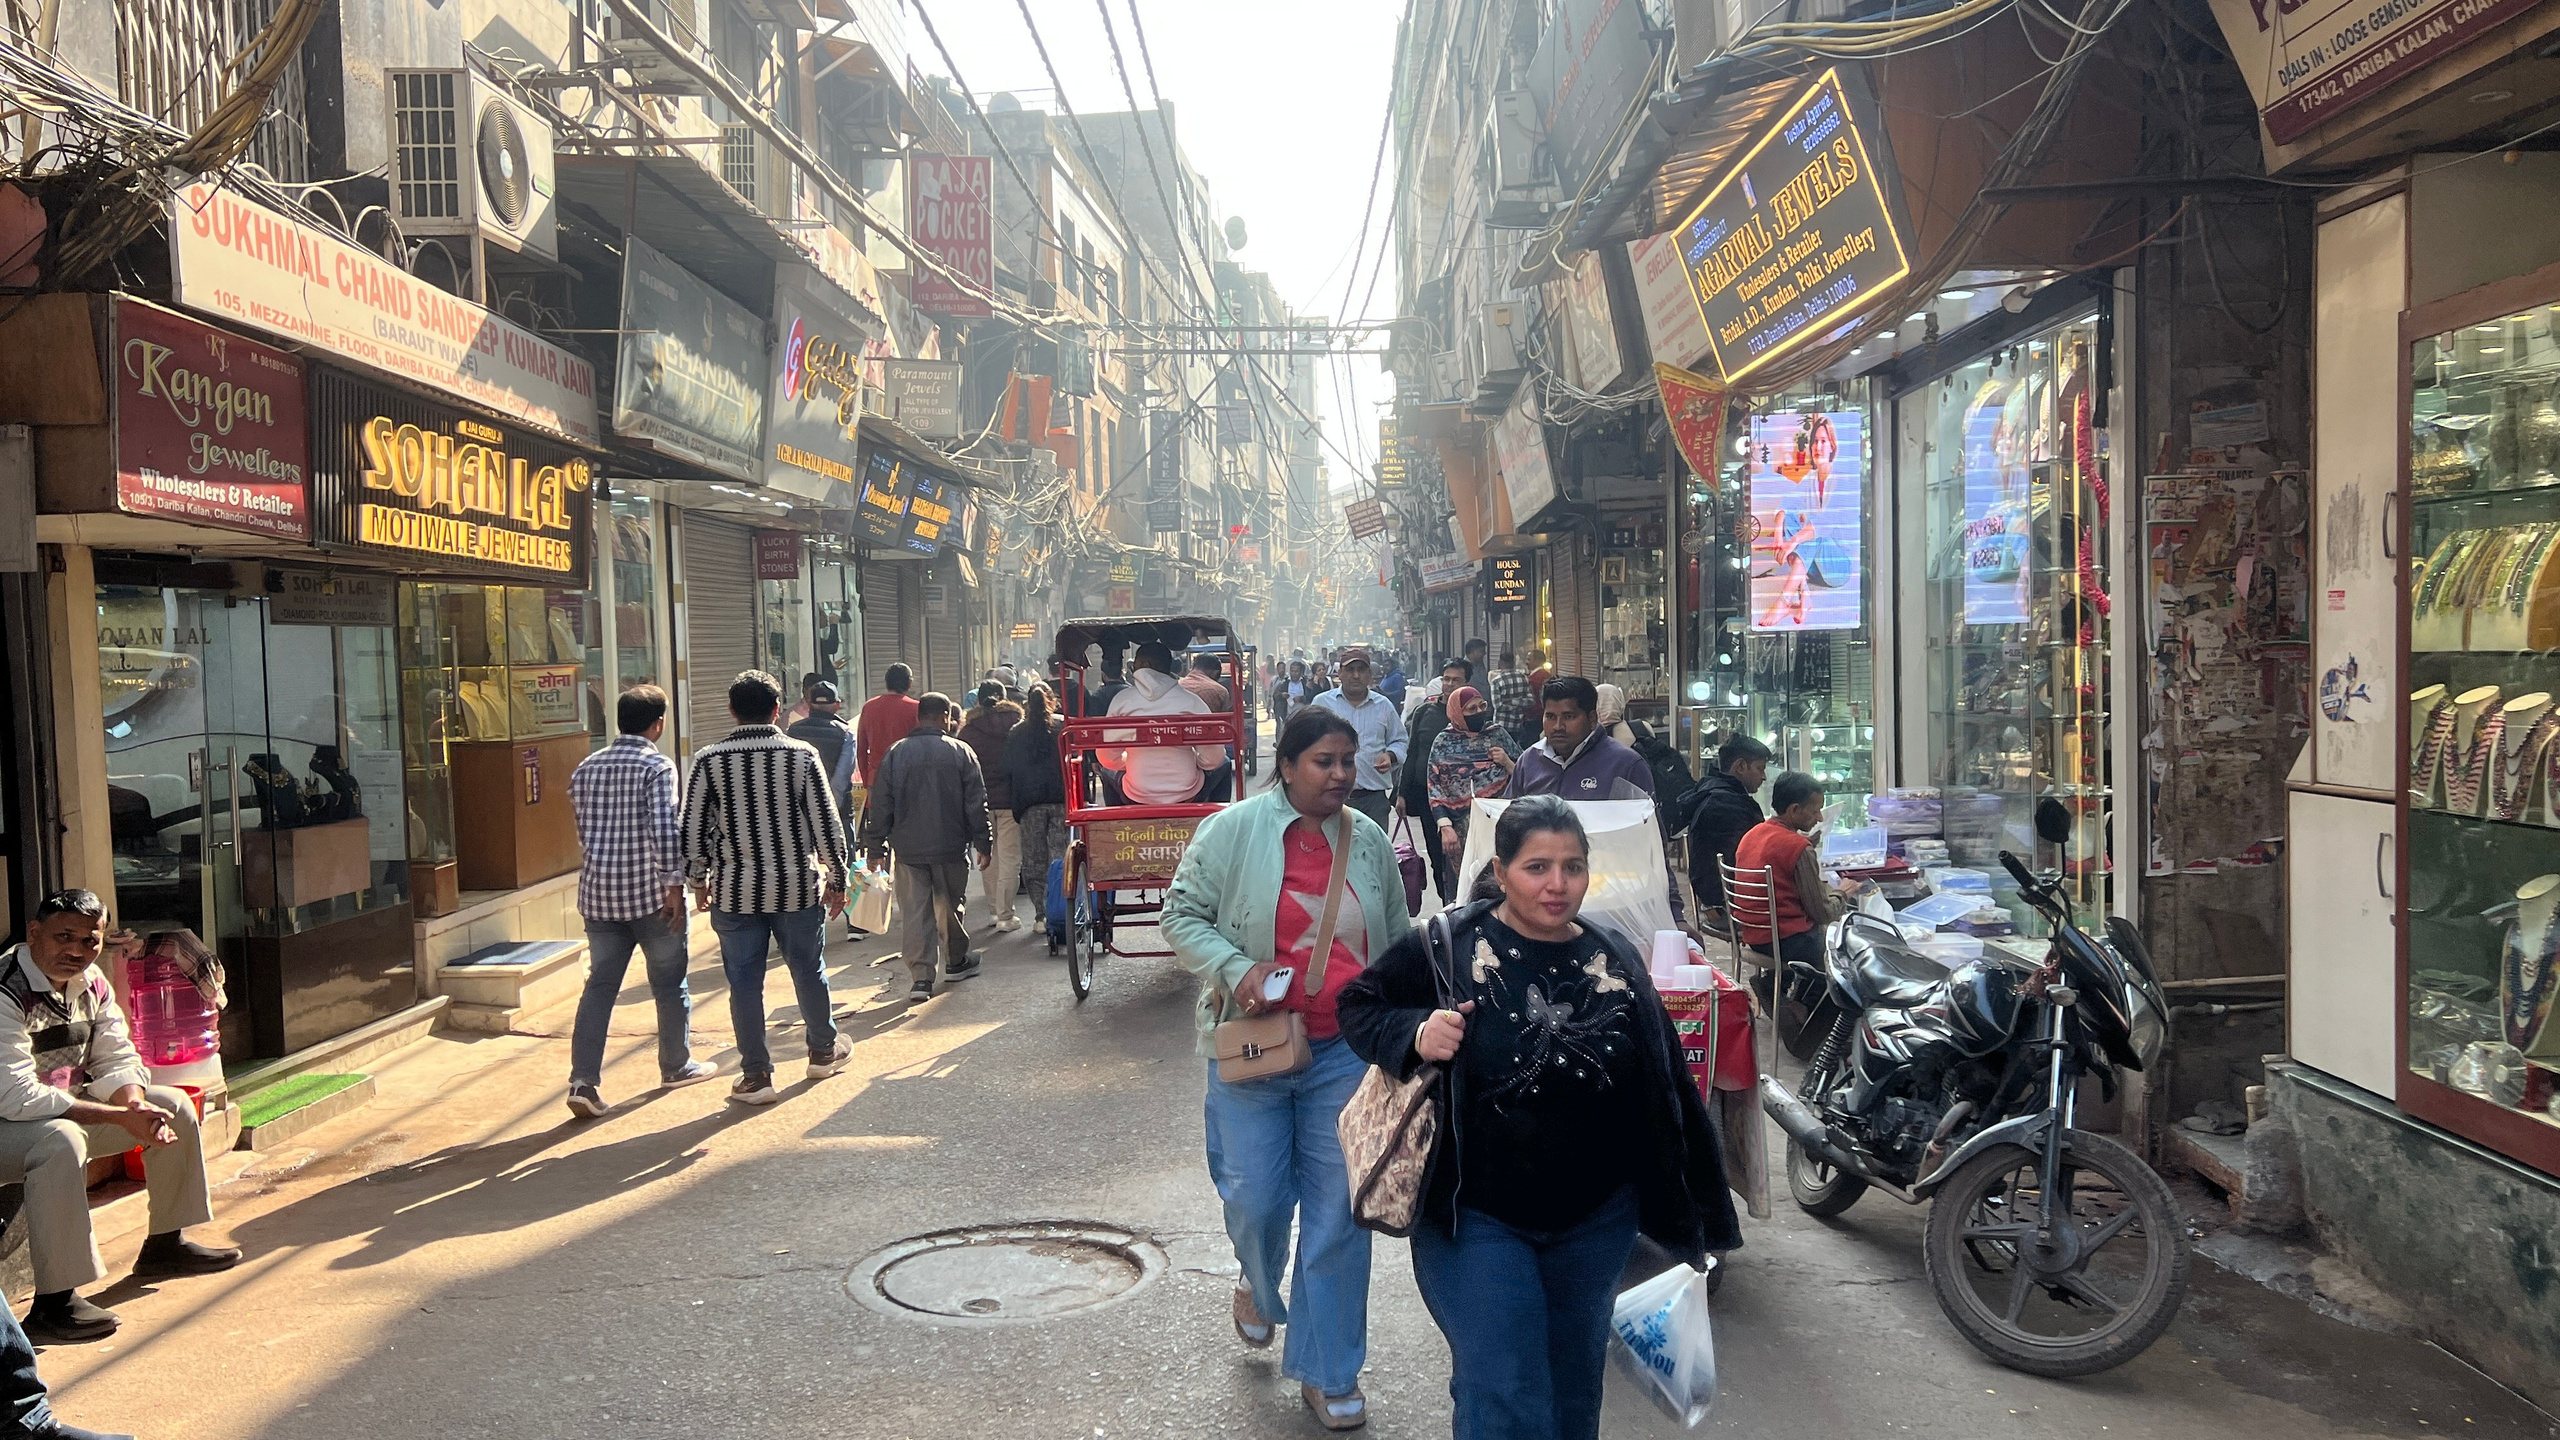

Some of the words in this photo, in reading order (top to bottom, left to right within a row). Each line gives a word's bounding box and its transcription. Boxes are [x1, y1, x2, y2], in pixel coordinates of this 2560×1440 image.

[2277, 57, 2310, 87] DEALS
[2310, 45, 2325, 70] IN
[2331, 23, 2369, 56] LOOSE
[2342, 48, 2397, 88] DARIBA
[2396, 17, 2453, 60] KALAN,
[916, 200, 988, 240] POCKET
[1695, 213, 1774, 304] AGARWAL
[1769, 136, 1858, 241] JEWELS
[1736, 265, 1781, 303] Wholesalers
[1778, 253, 1789, 273] &
[1784, 229, 1823, 268] Retailer
[1795, 257, 1825, 292] Polki
[1822, 226, 1876, 275] Jewellery
[190, 186, 330, 289] SUKHMAL
[336, 252, 412, 322] CHAND
[417, 288, 499, 358] SANDEEP
[503, 328, 558, 385] KUMAR
[562, 356, 592, 399] JAIN
[214, 289, 246, 318] 105,
[250, 301, 336, 348] MEZZANINE,
[339, 334, 382, 366] FLOOR,
[386, 351, 424, 376] DARIBA
[427, 366, 463, 392] KALAN,
[465, 380, 505, 405] CHANDNI
[373, 315, 435, 355] (BARAUT
[438, 341, 479, 375] WALE)
[124, 338, 274, 435] Kangan
[892, 367, 953, 381] Paramount
[903, 381, 942, 396] Jewels
[467, 420, 479, 435] JAI
[479, 425, 497, 440] GURU
[915, 419, 930, 428] 109
[187, 432, 302, 484] Jewellers
[363, 416, 506, 515] SOHAN
[510, 458, 572, 531] LAL
[572, 462, 589, 485] 105
[140, 467, 226, 503] Wholesalers
[228, 485, 240, 505] &
[242, 489, 294, 516] Retailer
[129, 492, 156, 509] 105/3,
[157, 499, 185, 512] Dariba
[187, 503, 212, 519] Kalan,
[214, 508, 247, 523] Chandni
[249, 515, 275, 530] Chowk,
[277, 520, 303, 534] Delhi-6
[371, 506, 477, 555] MOTIWALE
[482, 526, 572, 571] JEWELLERS
[762, 537, 790, 547] LUCKY
[761, 563, 794, 573] STONES
[764, 550, 790, 560] BIRTH
[1497, 560, 1521, 569] HOUSE
[348, 579, 374, 595] LAL
[1494, 580, 1525, 589] KUNDAN
[1503, 570, 1514, 579] OF
[1506, 589, 1513, 597] by
[173, 627, 212, 645] LAL
[538, 672, 571, 688] सोना
[1115, 846, 1136, 861] की
